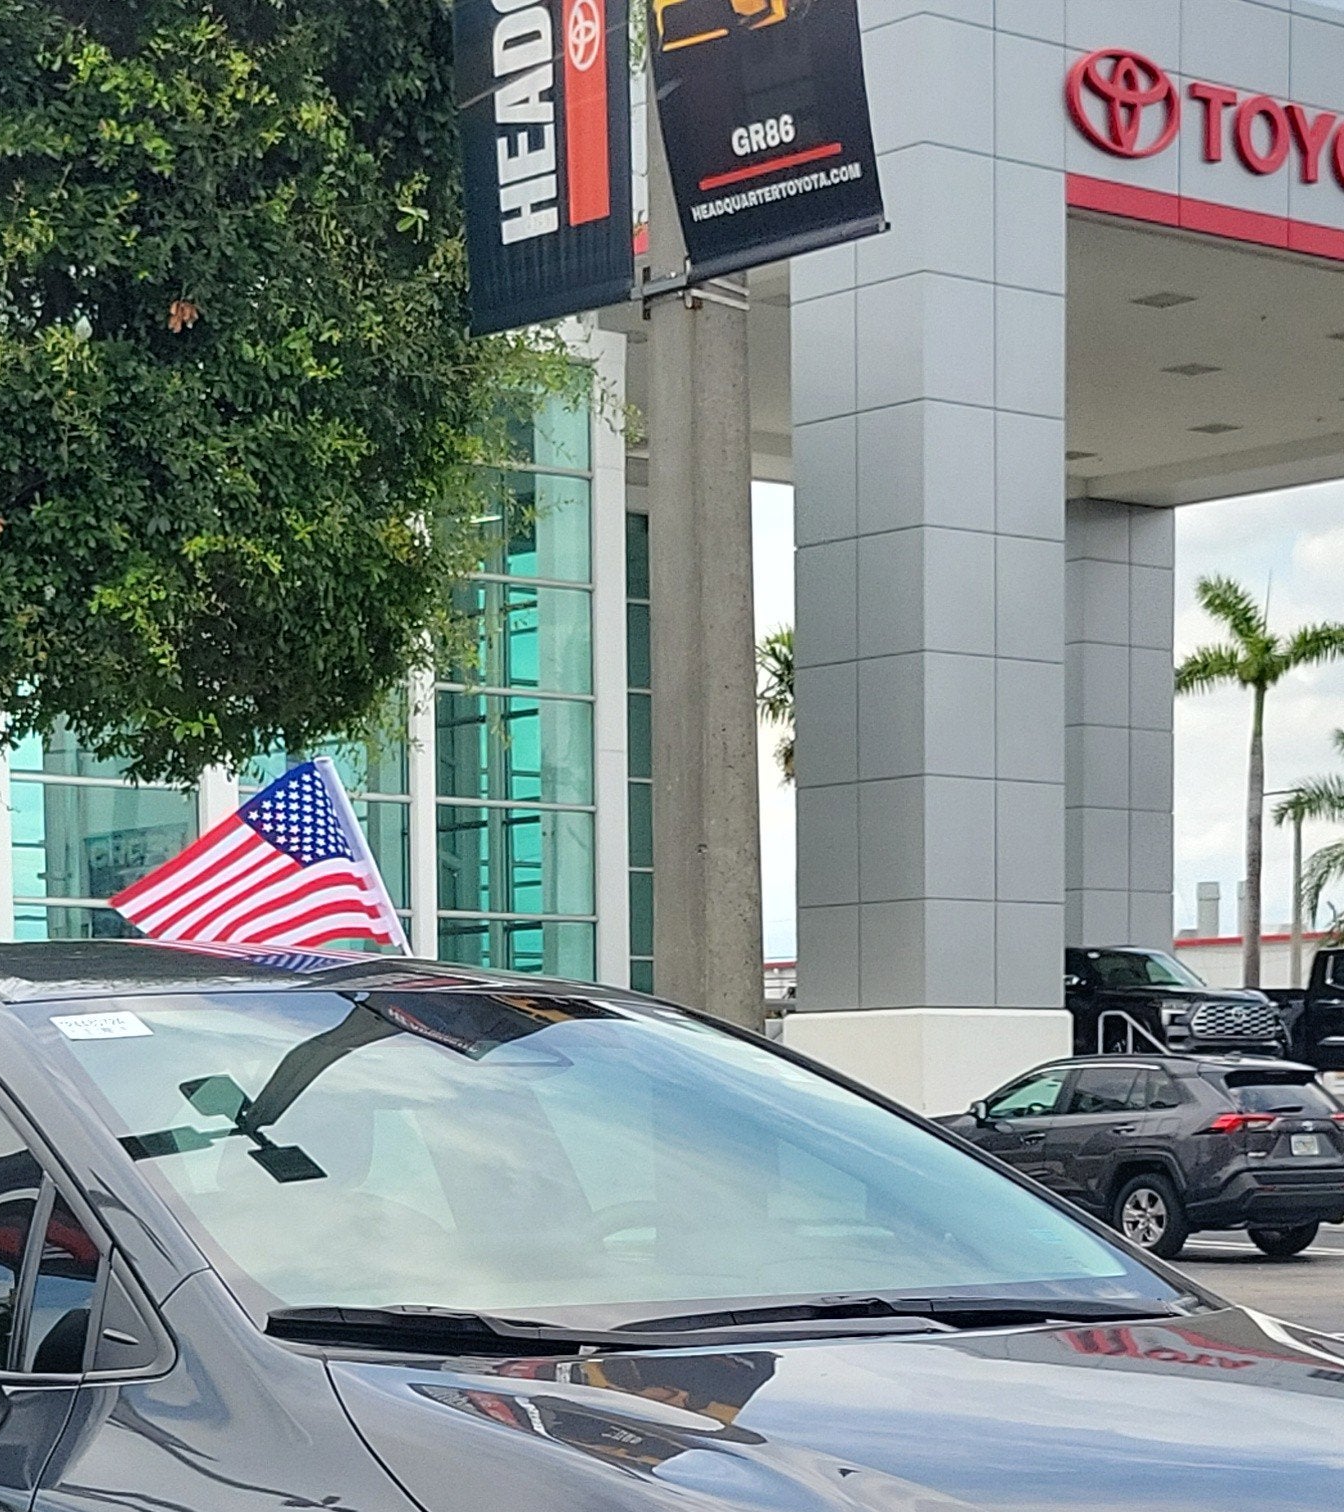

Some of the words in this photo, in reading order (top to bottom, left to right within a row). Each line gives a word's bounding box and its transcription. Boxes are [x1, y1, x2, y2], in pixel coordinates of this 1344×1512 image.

[492, 0, 559, 246] HEAD
[731, 114, 796, 157] GR86
[690, 161, 863, 222] HEADQUARTERTOYOTA.COM
